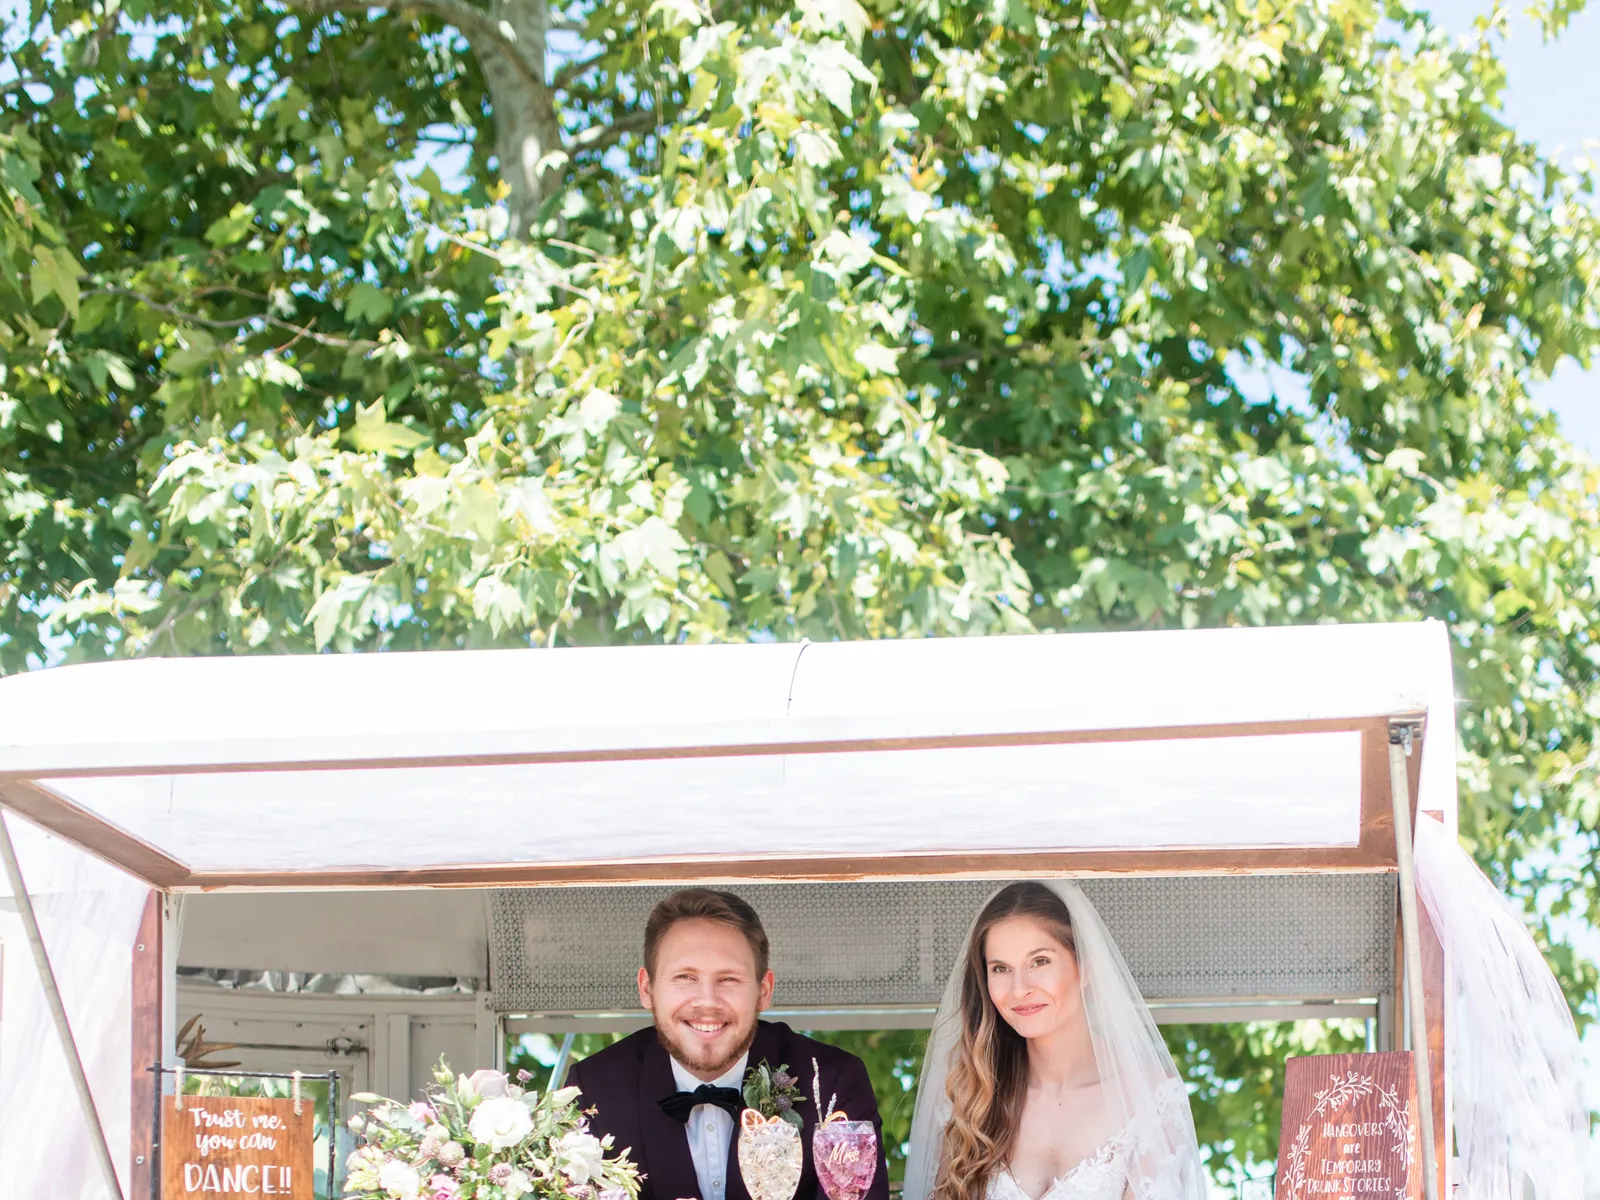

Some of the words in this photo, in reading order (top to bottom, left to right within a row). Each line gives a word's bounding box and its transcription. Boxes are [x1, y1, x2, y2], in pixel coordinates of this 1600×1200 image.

[188, 1107, 246, 1128] Trust
[1323, 1121, 1385, 1138] HANGOVERS
[196, 1133, 237, 1156] you
[240, 1133, 277, 1150] can
[1343, 1143, 1360, 1154] are
[1320, 1158, 1382, 1175] TEMPORARY
[184, 1163, 292, 1194] DANCE!!
[1307, 1178, 1343, 1194] DRUNK
[1343, 1177, 1392, 1193] STORIES
